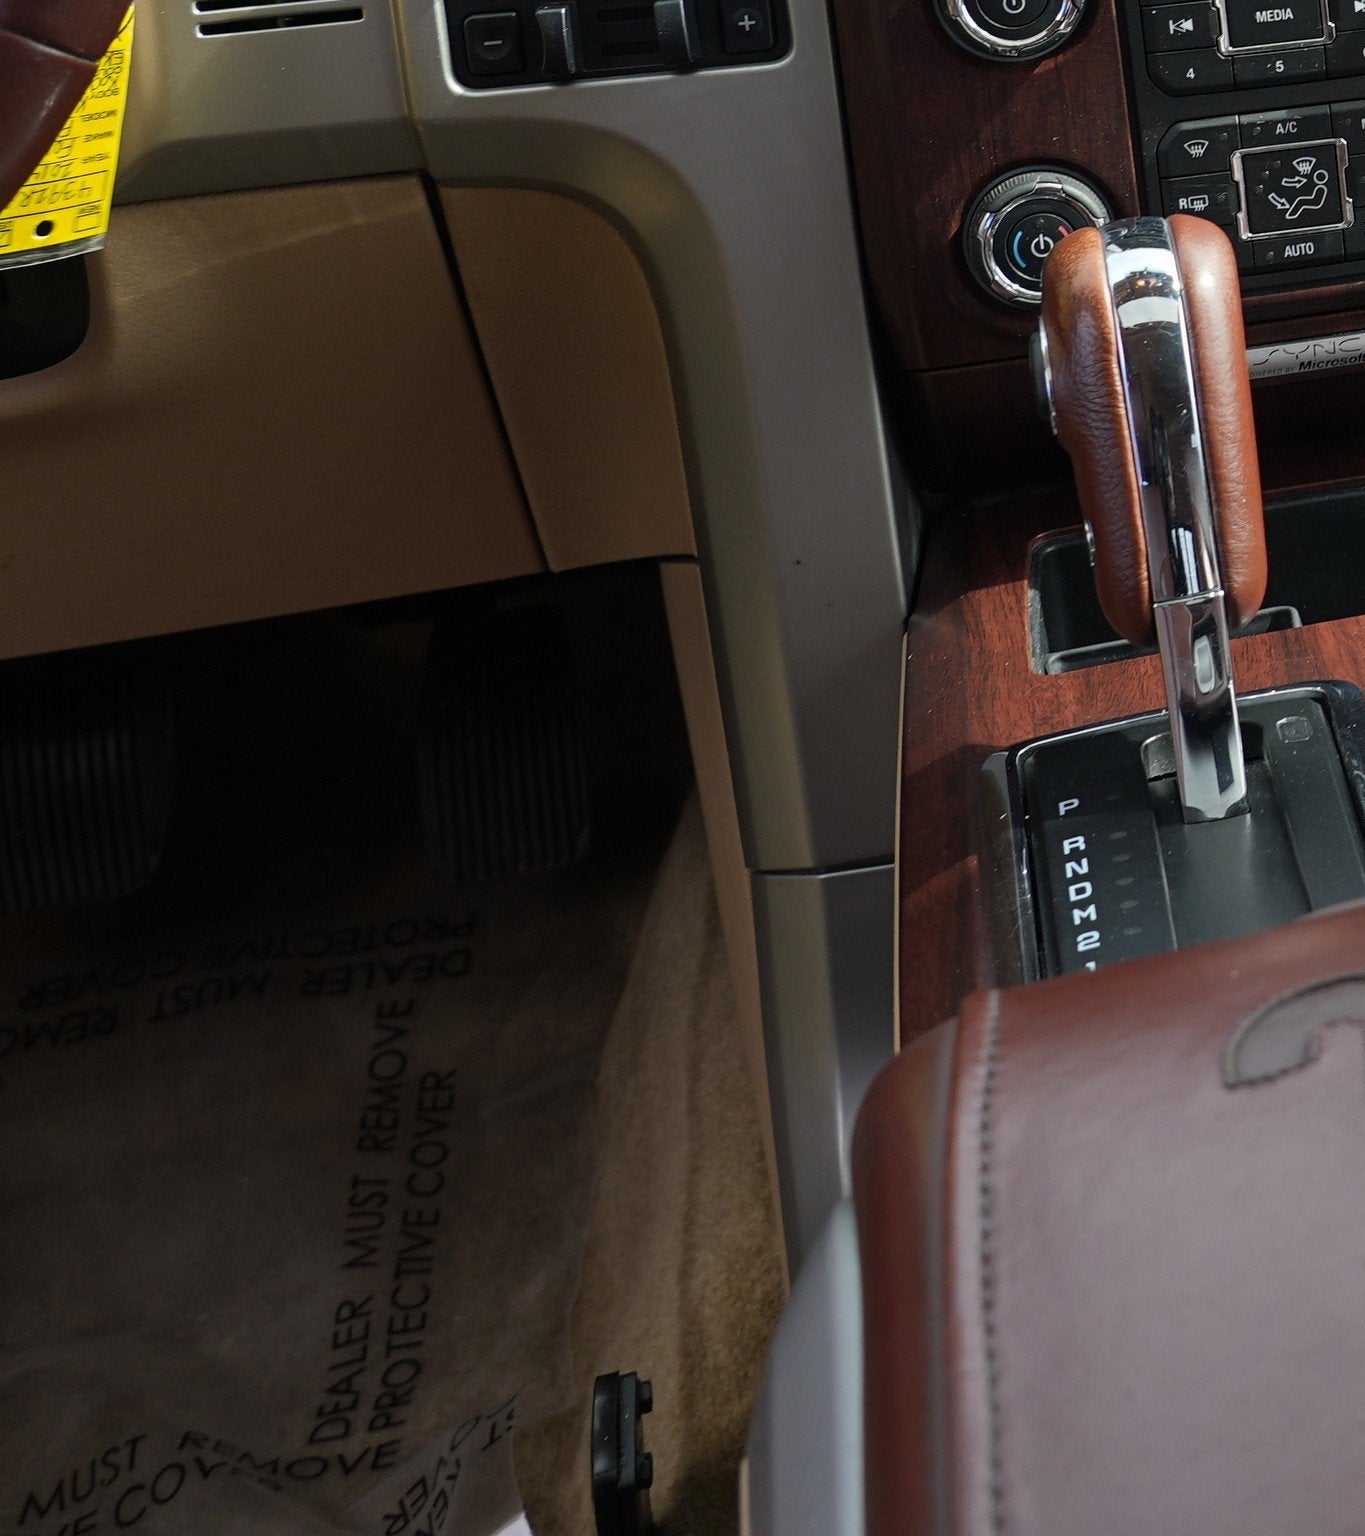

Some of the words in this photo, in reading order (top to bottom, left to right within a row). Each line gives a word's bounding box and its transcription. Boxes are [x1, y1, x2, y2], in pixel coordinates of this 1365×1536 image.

[1255, 8, 1294, 24] MEDIA
[1186, 67, 1195, 79] 4
[1275, 60, 1284, 73] 5
[1275, 122, 1298, 135] A/C
[1284, 242, 1315, 258] AUTO
[1253, 337, 1360, 366] SYNC
[1249, 368, 1283, 379] OWERED
[1298, 352, 1365, 372] Microsoft
[1058, 798, 1080, 816] P
[1062, 835, 1087, 855] R
[1065, 857, 1090, 879] N
[1068, 881, 1093, 902] D
[1072, 904, 1098, 926] M
[202, 912, 479, 973] PROTECTIVE
[1077, 930, 1101, 952] 2
[18, 951, 188, 1013] COVER
[300, 948, 472, 998] DEALER
[150, 968, 270, 1022] MUST
[359, 998, 416, 1154] REMOVE
[344, 1175, 390, 1272] MUST
[366, 1208, 440, 1434] PROTECTIVE
[407, 1067, 459, 1201] COVER
[310, 1295, 374, 1447] DEALER
[18, 1432, 148, 1526] MUST
